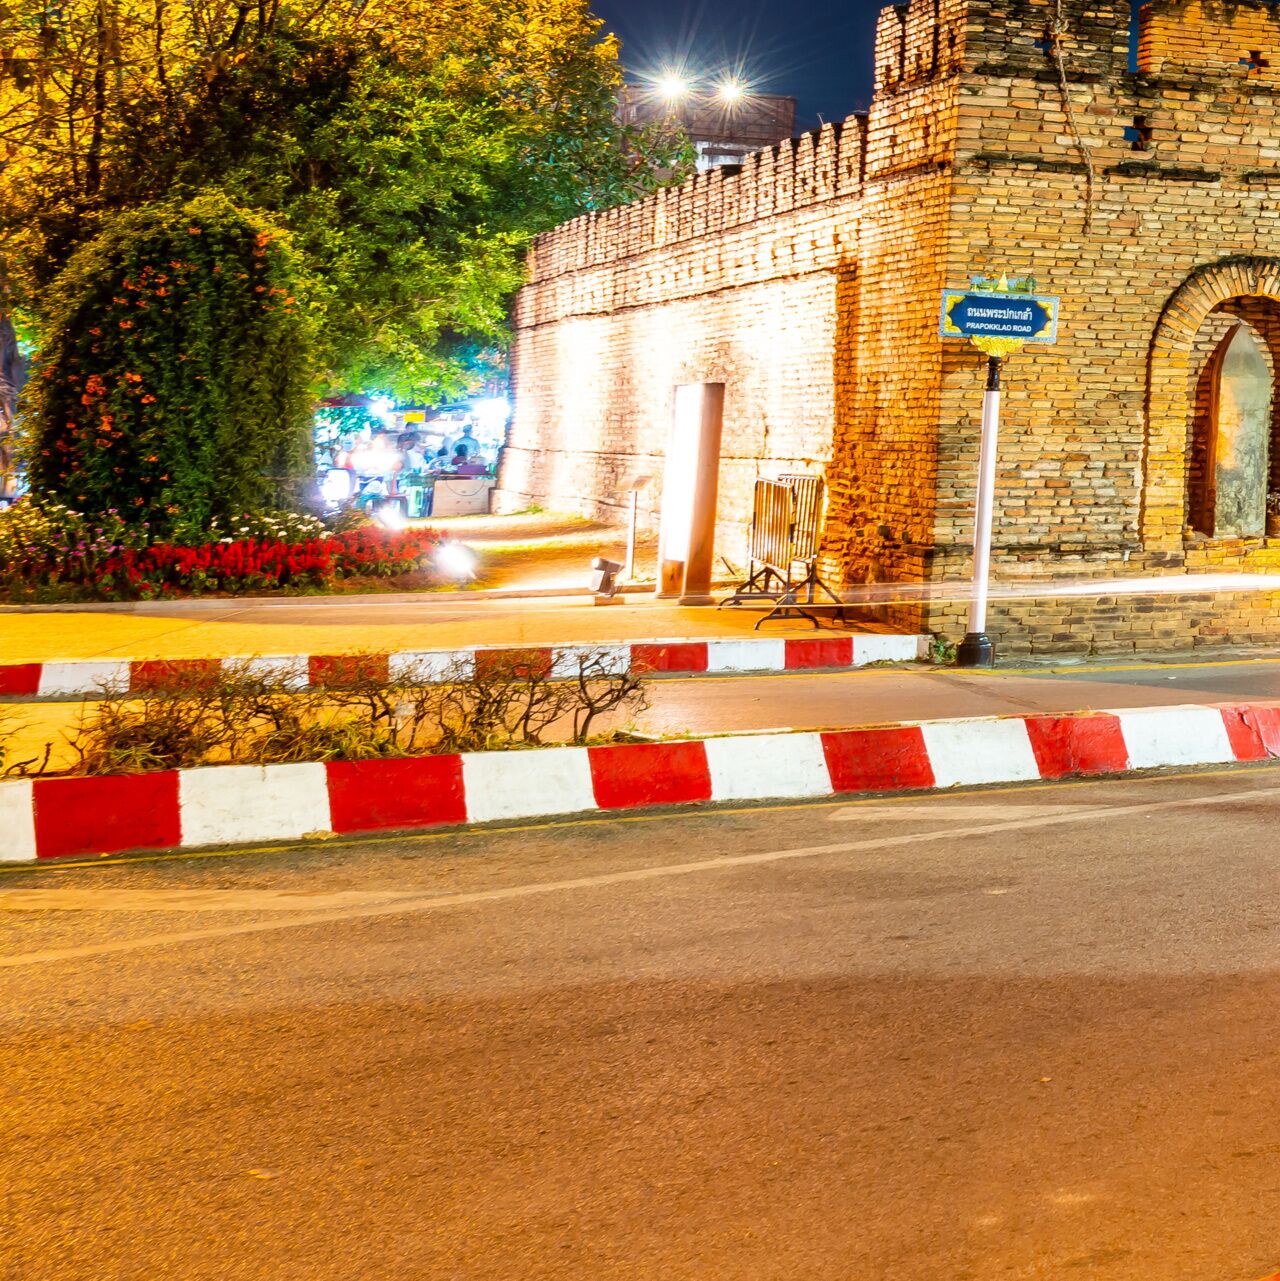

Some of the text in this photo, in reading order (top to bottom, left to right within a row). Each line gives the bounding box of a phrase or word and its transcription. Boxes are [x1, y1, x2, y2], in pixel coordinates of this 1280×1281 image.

[967, 307, 1033, 321] ถนนพระปกเกล้า
[1012, 324, 1032, 332] ROAD
